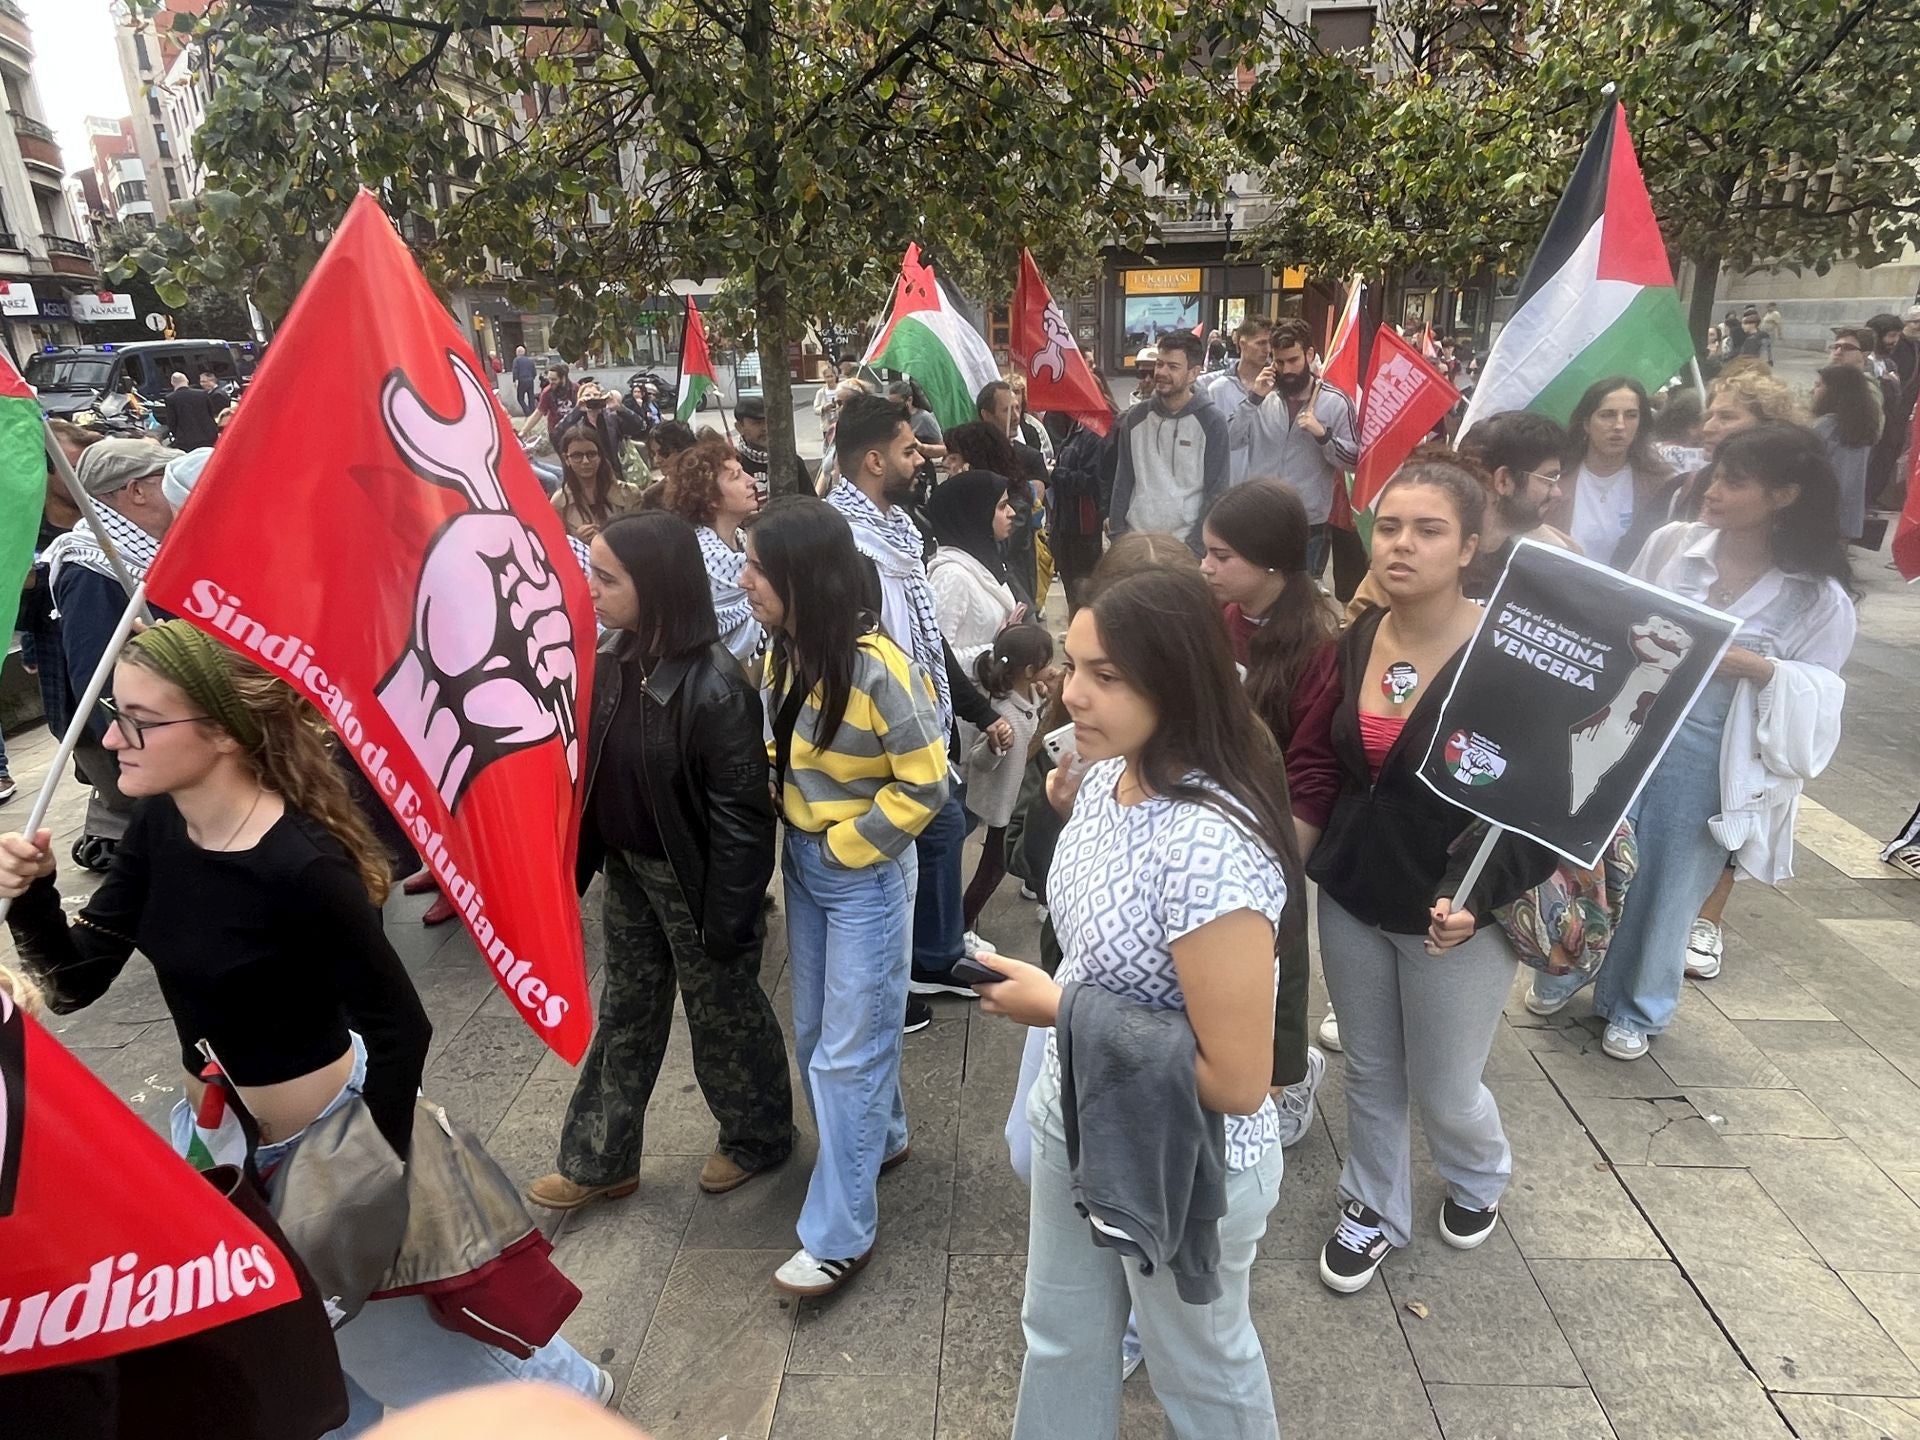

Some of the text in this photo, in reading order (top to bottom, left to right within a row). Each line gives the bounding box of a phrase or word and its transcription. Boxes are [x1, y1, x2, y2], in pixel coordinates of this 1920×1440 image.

[822, 327, 858, 336] GACIAS
[1498, 610, 1604, 669] PALESTINA
[1506, 601, 1532, 618] desde
[1532, 614, 1544, 622] el
[1557, 623, 1580, 640] hasta
[1580, 636, 1592, 645] el
[1591, 641, 1613, 652] mar
[1493, 629, 1595, 691] VENCERA
[182, 579, 570, 1028] Sindicato de Estudiantes
